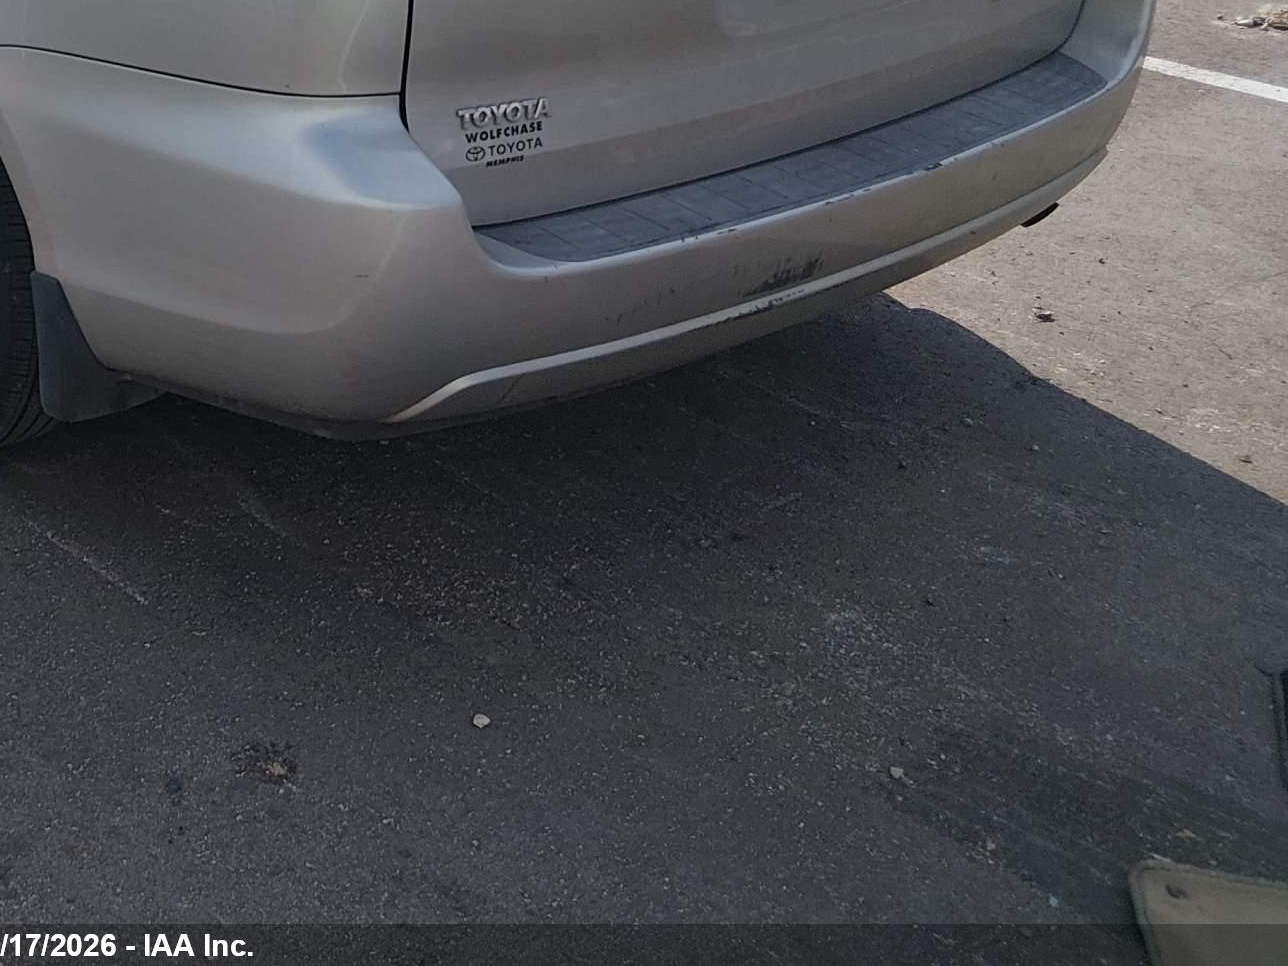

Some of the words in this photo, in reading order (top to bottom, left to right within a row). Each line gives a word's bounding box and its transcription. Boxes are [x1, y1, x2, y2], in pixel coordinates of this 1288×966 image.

[455, 97, 552, 130] TOYOTA
[465, 121, 543, 144] WOLFCHASE
[488, 137, 543, 157] TOYOTA
[485, 155, 524, 167] MEMPHIS
